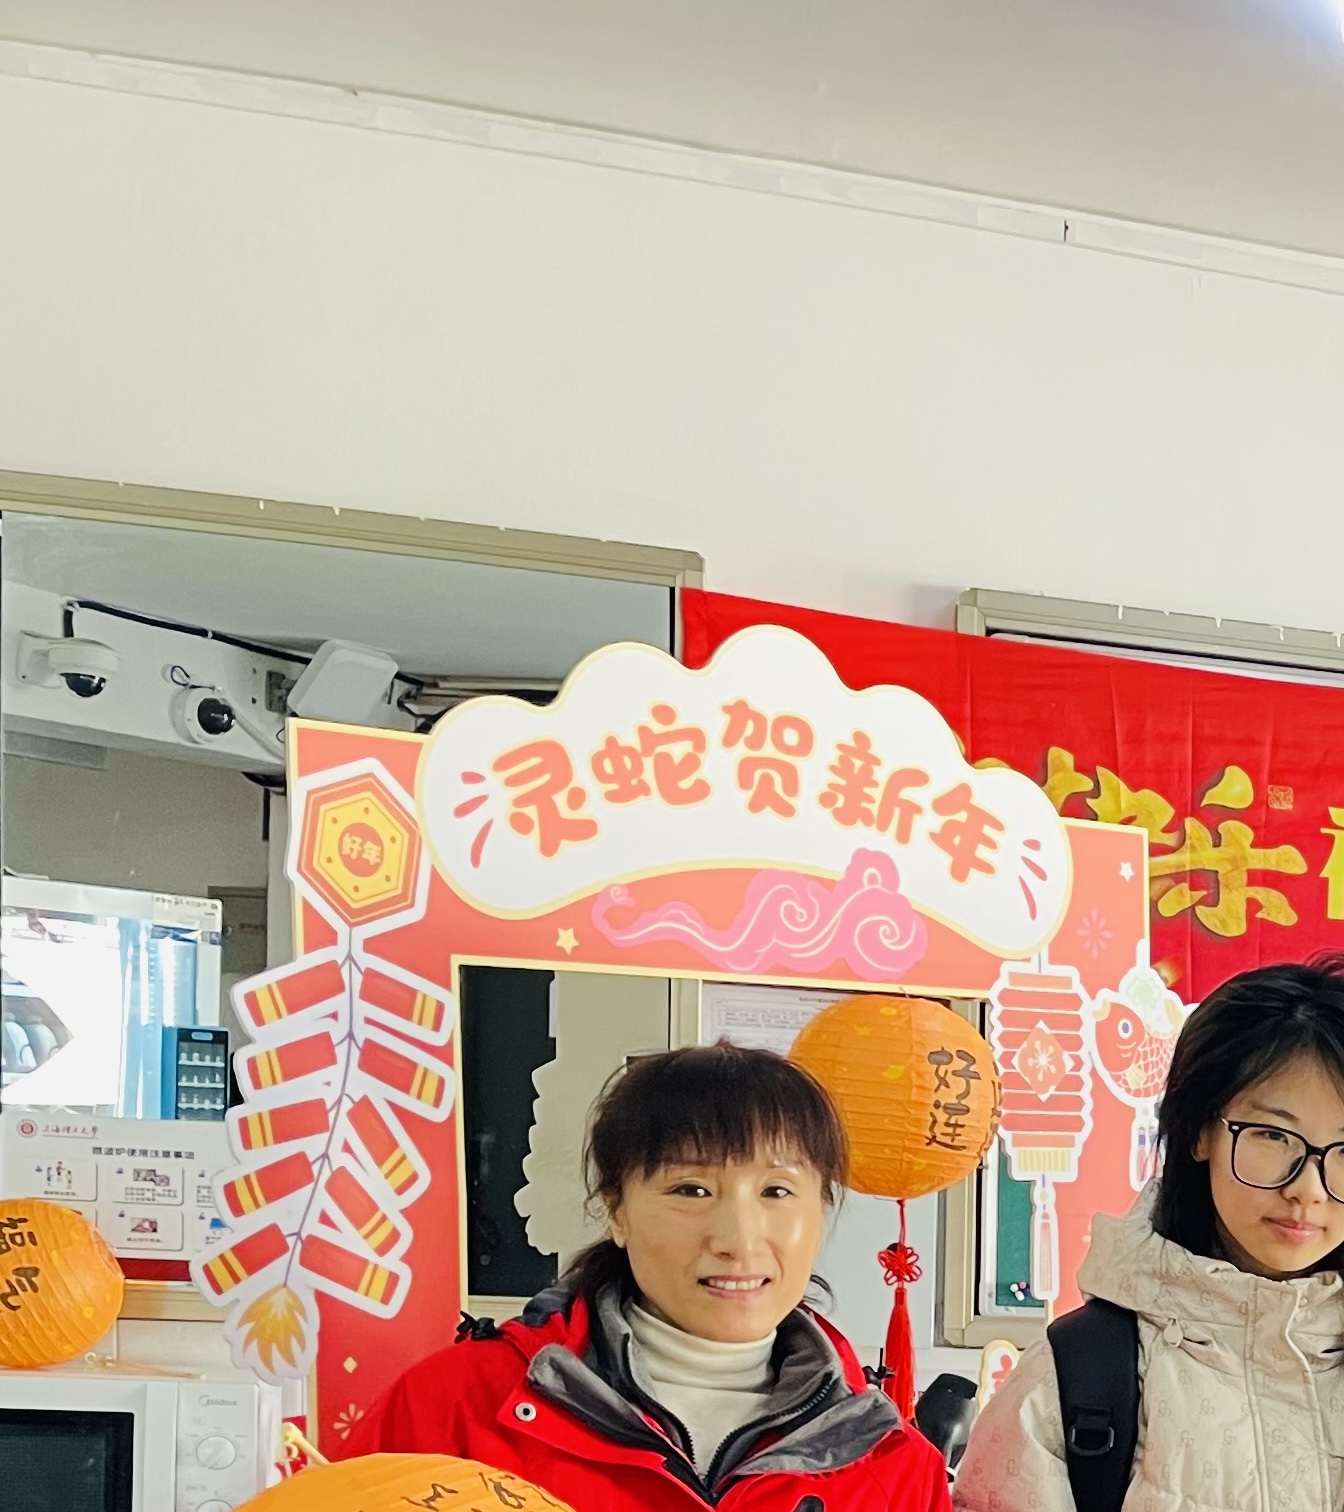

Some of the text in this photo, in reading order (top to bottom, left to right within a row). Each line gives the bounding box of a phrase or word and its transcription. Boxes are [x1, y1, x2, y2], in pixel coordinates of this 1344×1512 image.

[492, 699, 1005, 884] 灵蛇贺新年
[342, 832, 382, 866] 好年
